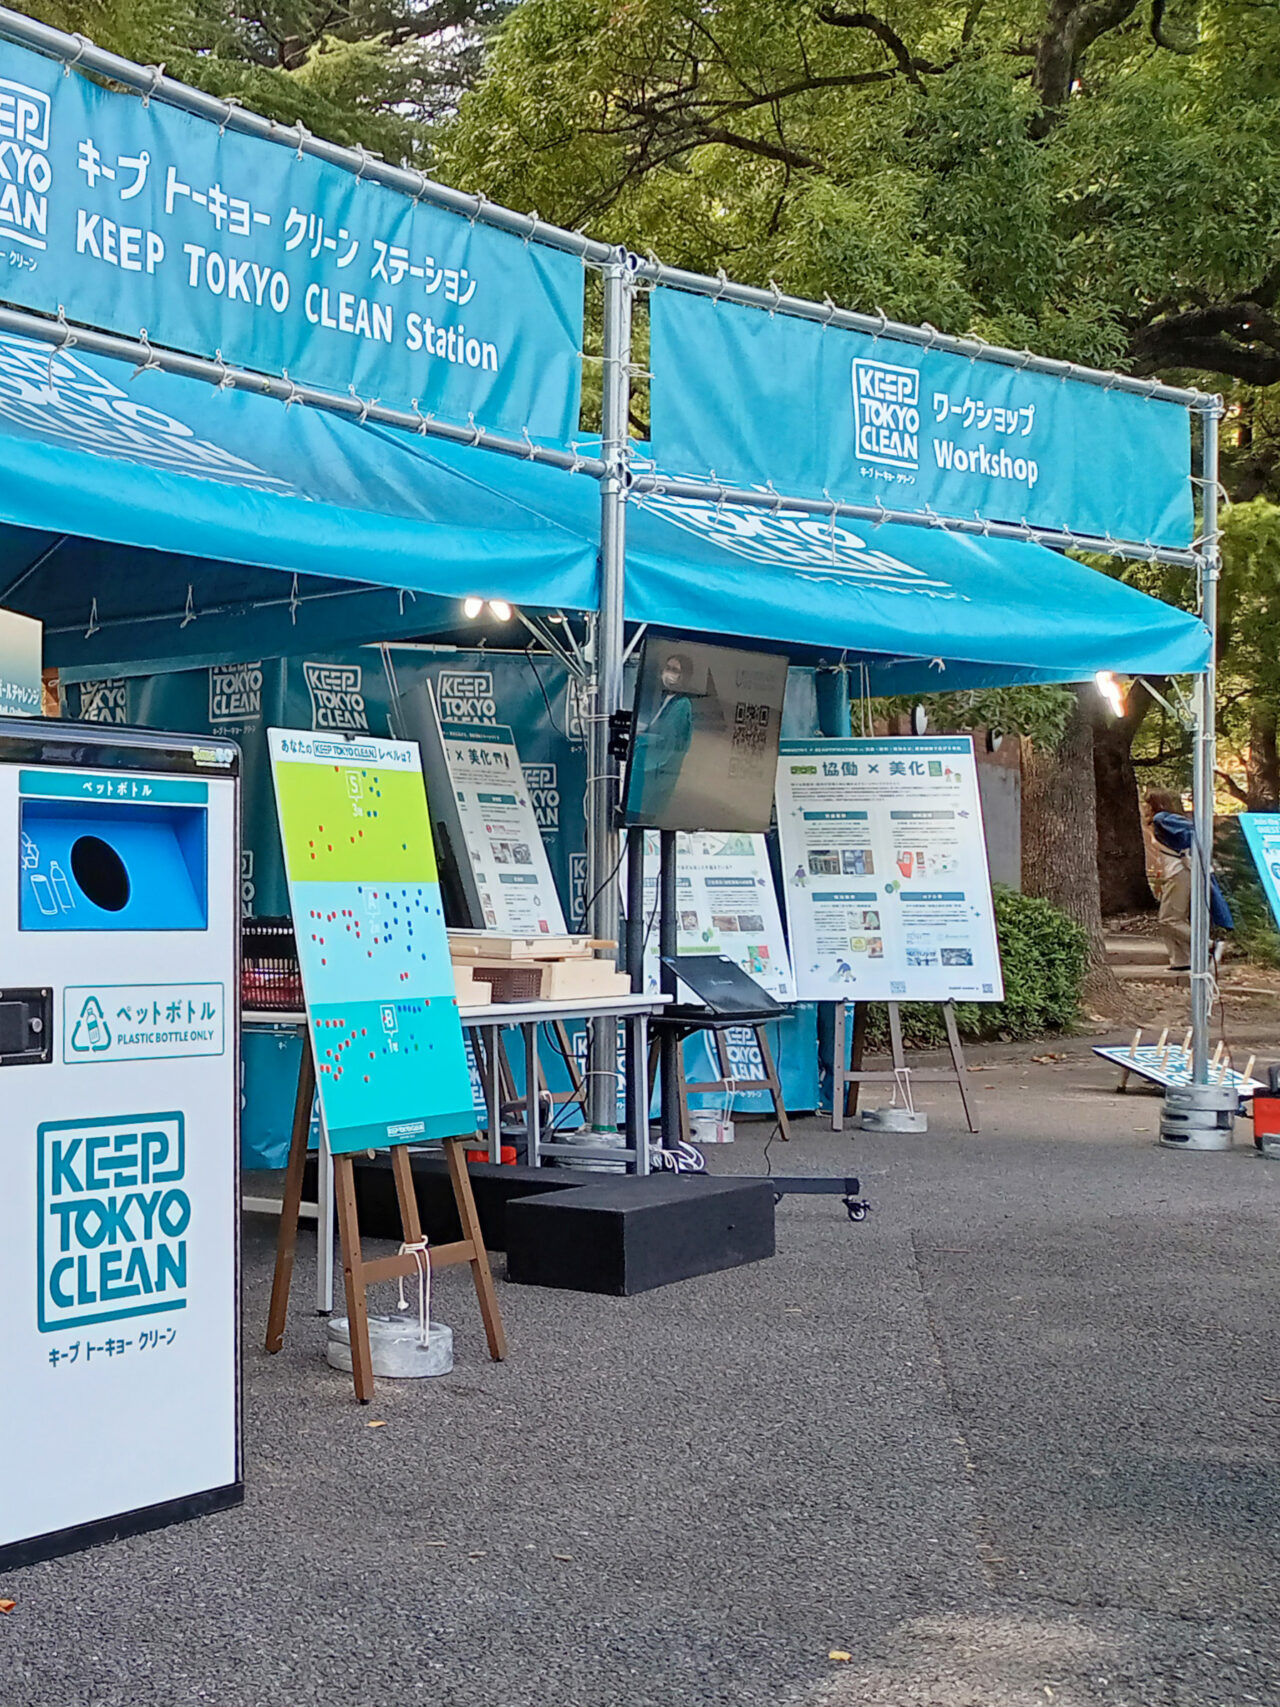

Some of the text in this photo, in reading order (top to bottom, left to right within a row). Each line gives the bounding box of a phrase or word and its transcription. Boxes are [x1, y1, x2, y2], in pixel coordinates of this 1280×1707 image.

[78, 137, 477, 306] キープ トーキョー クリーン ステーション
[9, 251, 38, 272] クリーン
[76, 209, 498, 372] KEEP TOKYO CLEAN Station
[859, 367, 912, 402] KEEP
[860, 398, 919, 433] TOKYO
[933, 392, 1035, 437] ワークショップ
[861, 427, 918, 460] CLEAN
[933, 439, 1039, 489] Workshop
[213, 670, 263, 694] TOKYO
[308, 669, 355, 691] KEEP
[441, 677, 487, 697] KEEP
[213, 691, 261, 715] CLEAN
[313, 689, 365, 711] TOKYO
[441, 698, 496, 717] TOKYO
[317, 708, 369, 730] CLEAN
[281, 739, 312, 754] あなたの
[315, 744, 332, 755] KEEP
[332, 745, 354, 757] TOKYO
[354, 747, 375, 759] CLEAN
[822, 761, 858, 776] 協働
[889, 761, 925, 776] 美化
[82, 780, 153, 798] ペットボトル
[529, 790, 560, 807] KYO
[116, 999, 216, 1025] ペットボトル
[117, 1030, 214, 1045] PLASTIC BOTTLE ONLY
[51, 1131, 170, 1196] KEEP
[50, 1188, 191, 1252] TOKYO
[49, 1240, 187, 1309] CLEAN
[48, 1327, 177, 1368] キープ トーキョー クリーン
